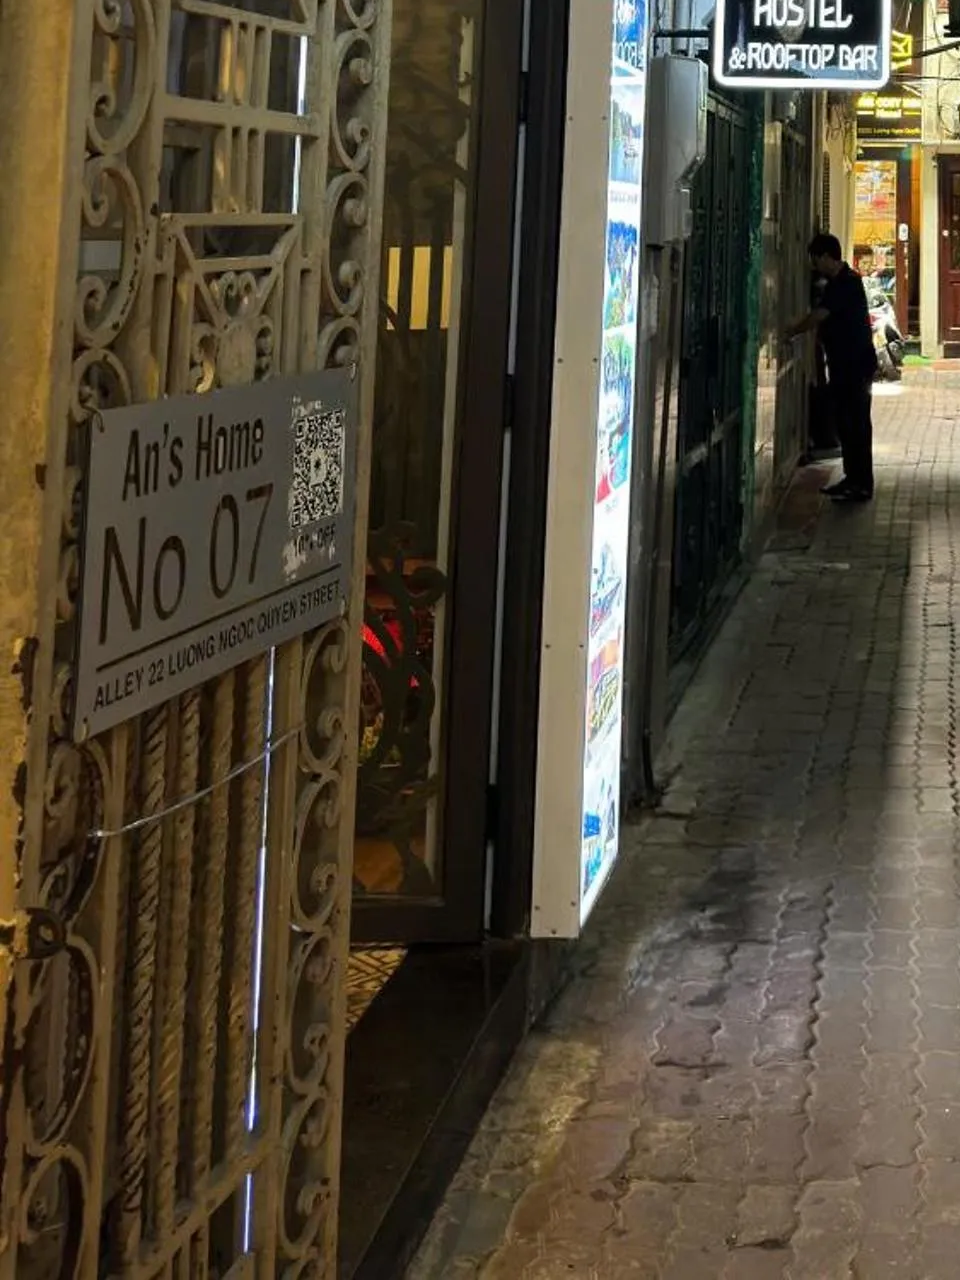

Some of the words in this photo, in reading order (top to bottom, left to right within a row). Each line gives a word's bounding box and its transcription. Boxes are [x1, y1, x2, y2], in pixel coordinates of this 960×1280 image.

[838, 44, 878, 70] BAR
[122, 423, 183, 501] An's
[195, 414, 264, 480] Home
[99, 517, 187, 645] No
[210, 482, 273, 599] 07
[94, 671, 143, 712] ALLEY
[148, 659, 164, 685] 22
[168, 635, 214, 676] LUONG
[218, 618, 254, 653] NGOC
[257, 601, 297, 635] QUYEN
[300, 580, 339, 614] STREET
